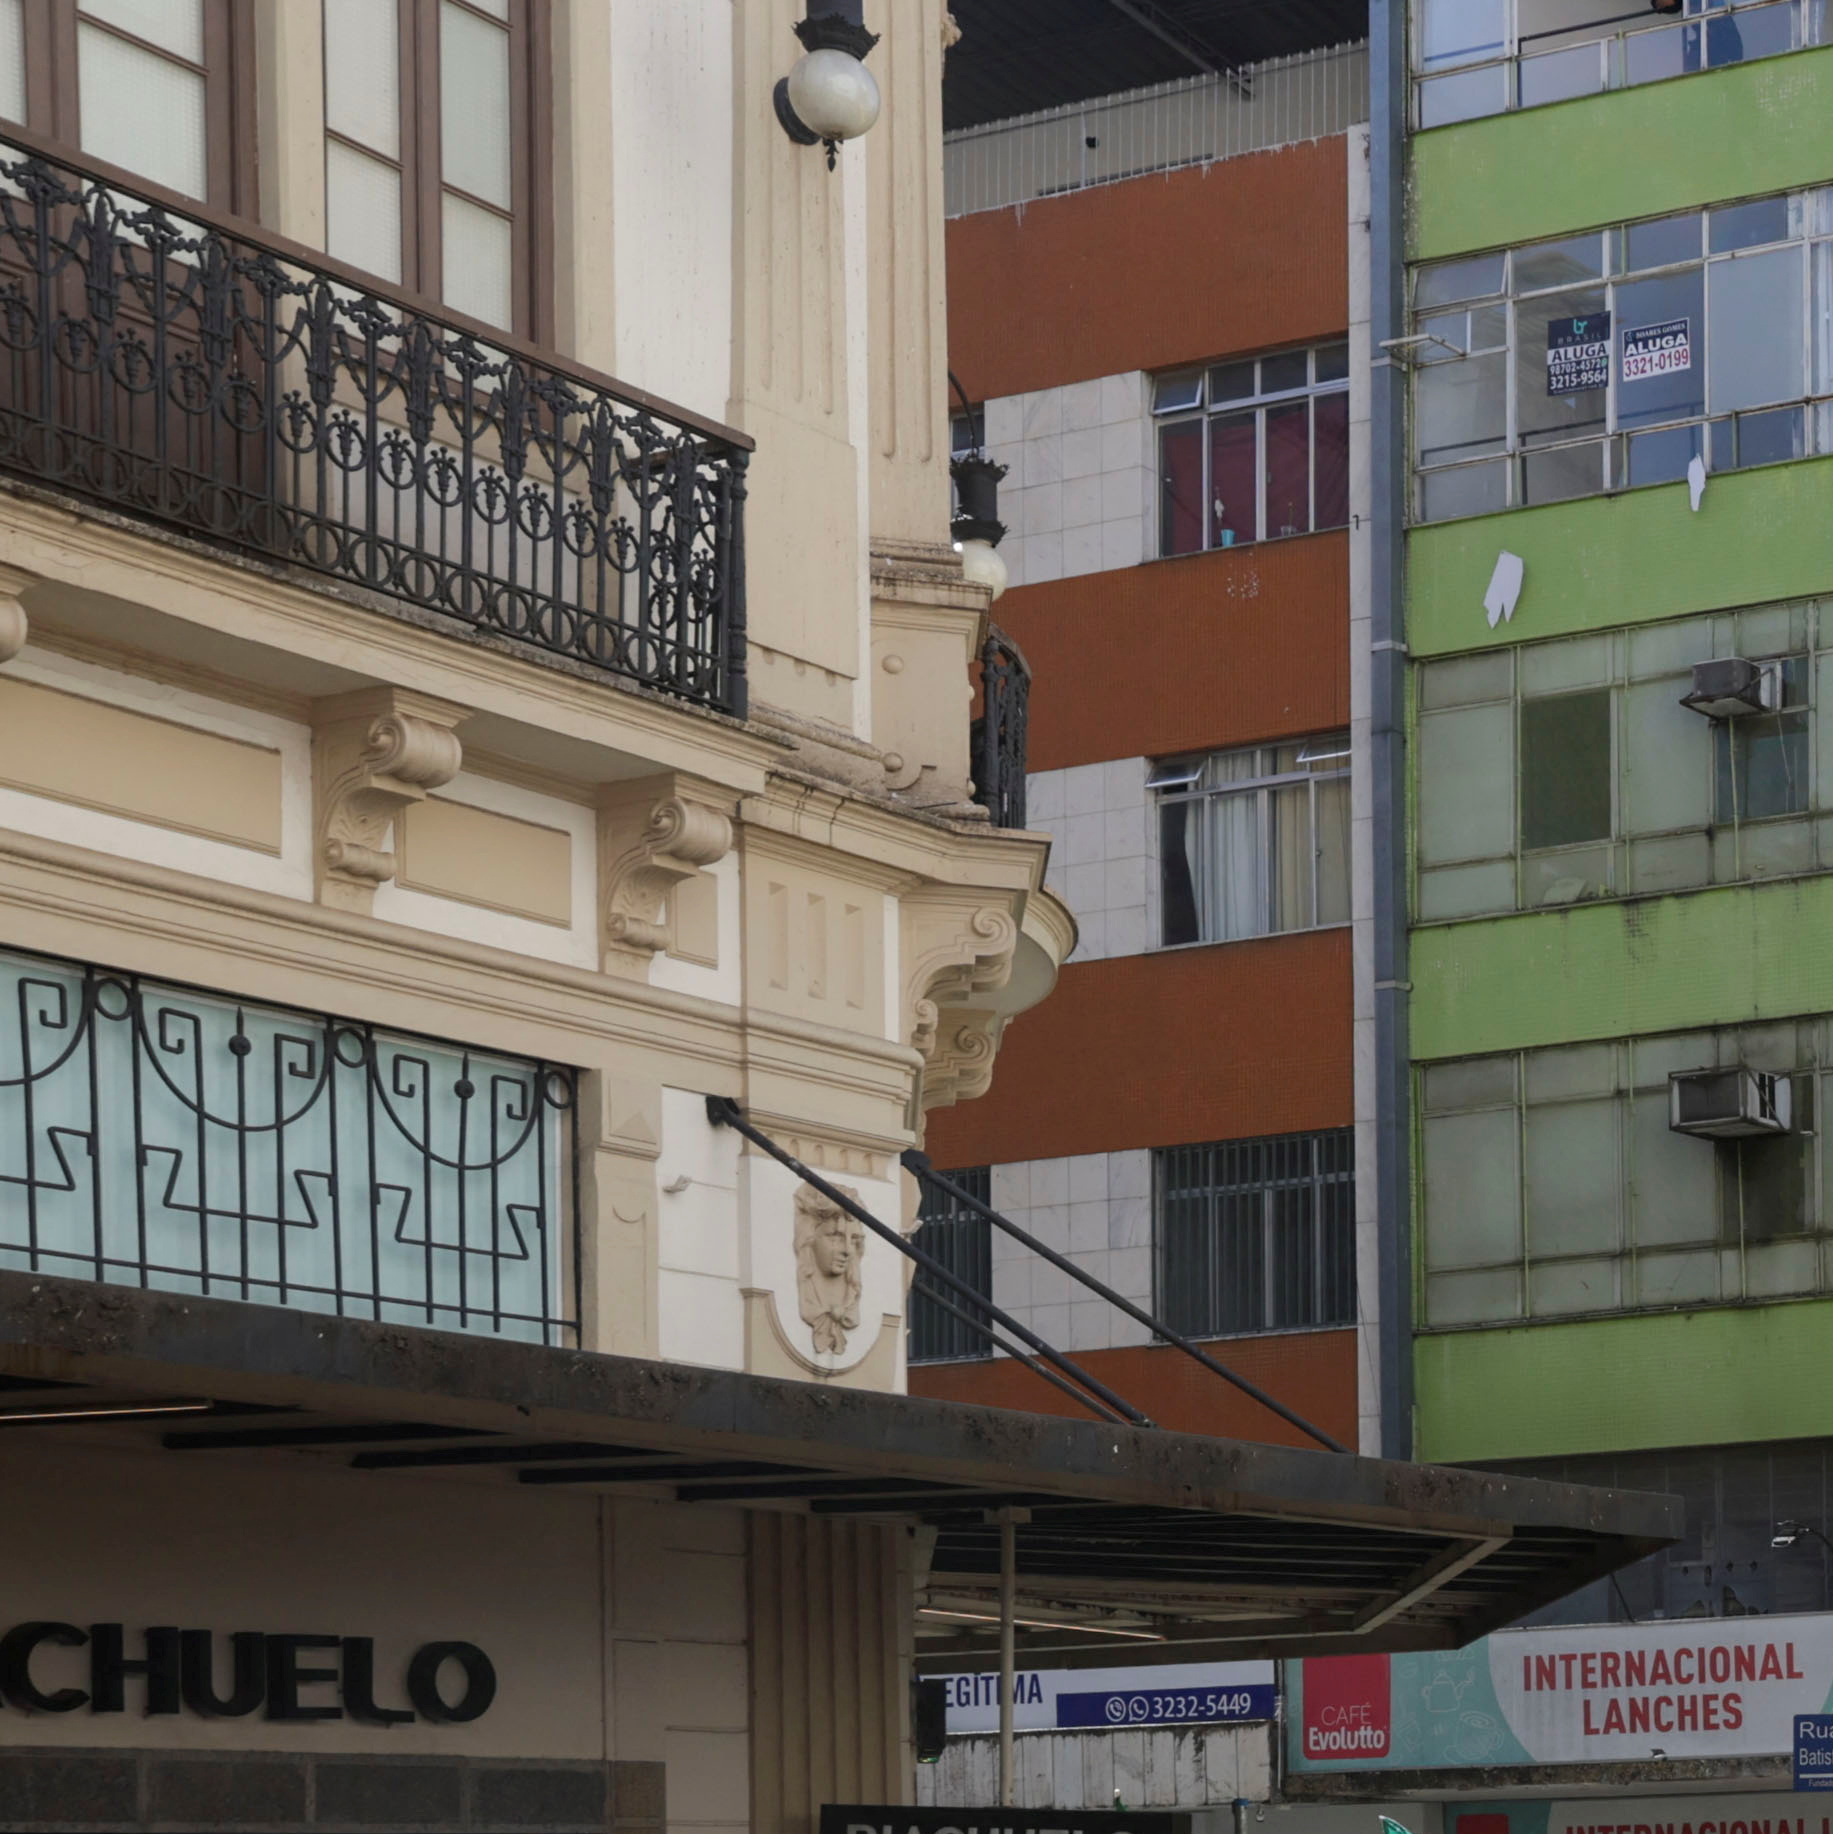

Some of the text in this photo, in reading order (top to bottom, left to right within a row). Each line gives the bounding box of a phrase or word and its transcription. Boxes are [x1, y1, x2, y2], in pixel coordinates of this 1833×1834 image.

[1552, 342, 1607, 363] ALUGA
[1625, 333, 1687, 357] ALUGA
[1625, 348, 1689, 378] 3321-0199
[1550, 369, 1607, 390] 3215-9564
[0, 1621, 497, 1724] CHUELO
[1523, 1642, 1804, 1692] INTERNACIONAL
[1152, 1693, 1251, 1719] 3232-5449
[1321, 1702, 1373, 1726] CAFÉ
[1583, 1692, 1743, 1736] LANCHES
[1309, 1725, 1385, 1751] Evolutto
